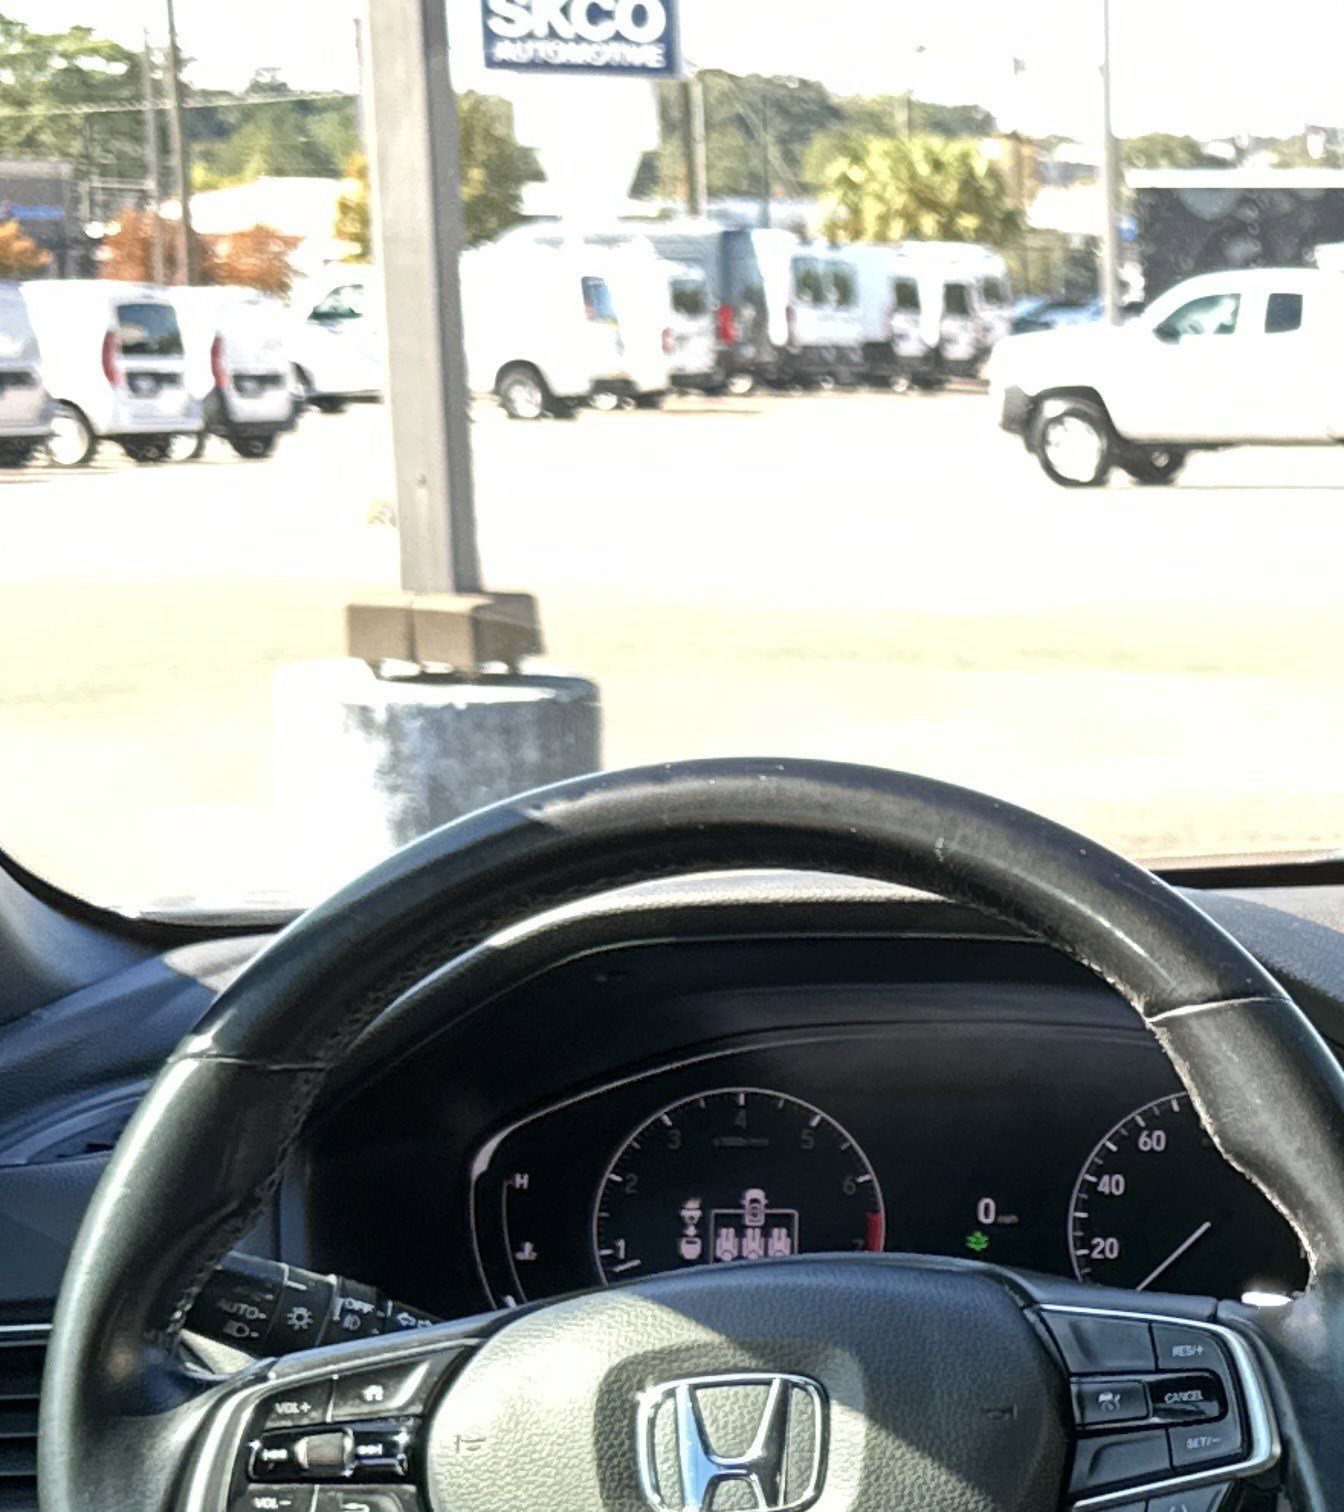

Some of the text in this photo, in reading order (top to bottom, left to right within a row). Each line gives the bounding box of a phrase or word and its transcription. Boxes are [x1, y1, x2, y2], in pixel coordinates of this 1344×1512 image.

[487, 0, 666, 43] SKCO
[1137, 1129, 1167, 1152] 60
[513, 1173, 529, 1189] H
[1096, 1172, 1127, 1196] 40
[977, 1197, 996, 1225] 0
[1090, 1236, 1120, 1260] 20
